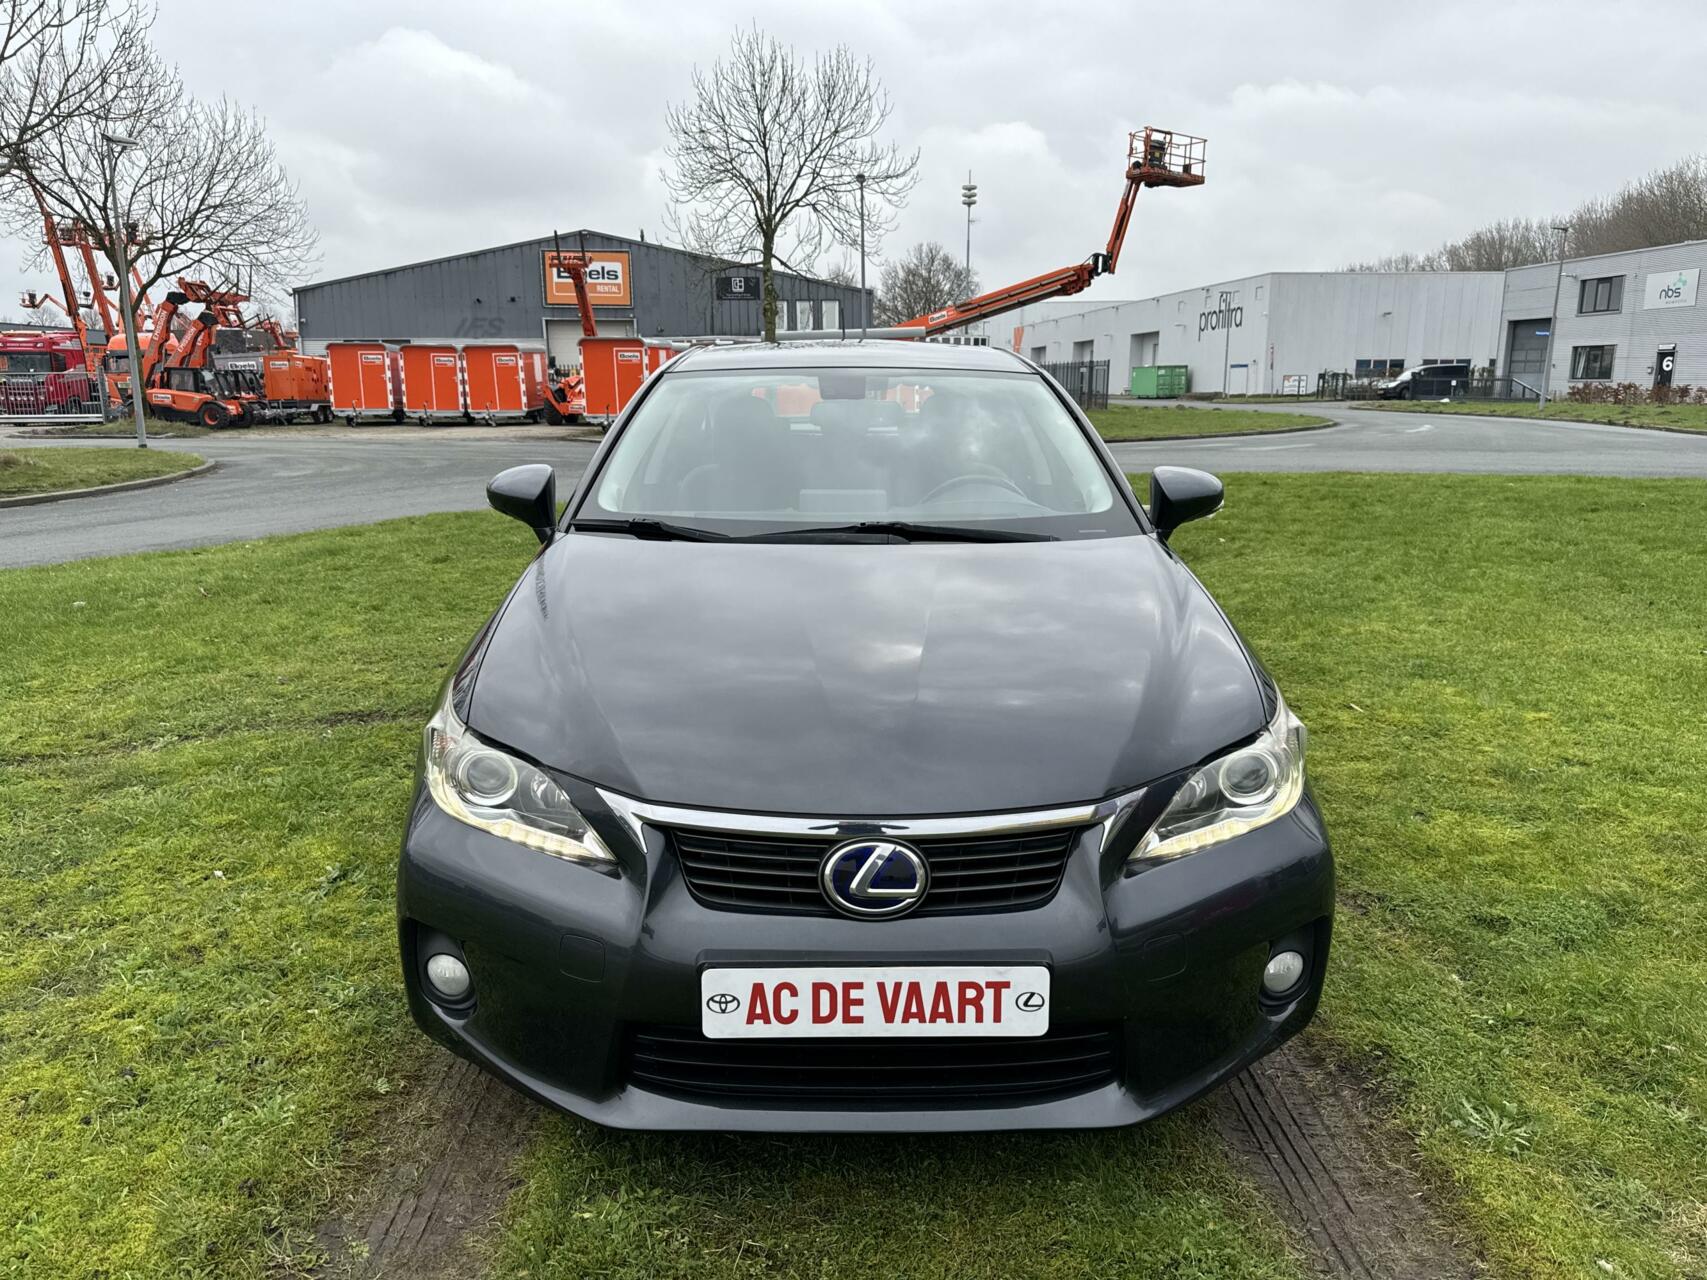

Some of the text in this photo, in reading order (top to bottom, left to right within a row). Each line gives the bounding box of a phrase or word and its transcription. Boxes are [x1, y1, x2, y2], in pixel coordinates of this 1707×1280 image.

[596, 284, 619, 293] RENTAL
[1659, 285, 1681, 299] nbs
[229, 362, 256, 370] Boels
[1662, 356, 1673, 371] 6
[745, 980, 1011, 1025] AC DE VAART
